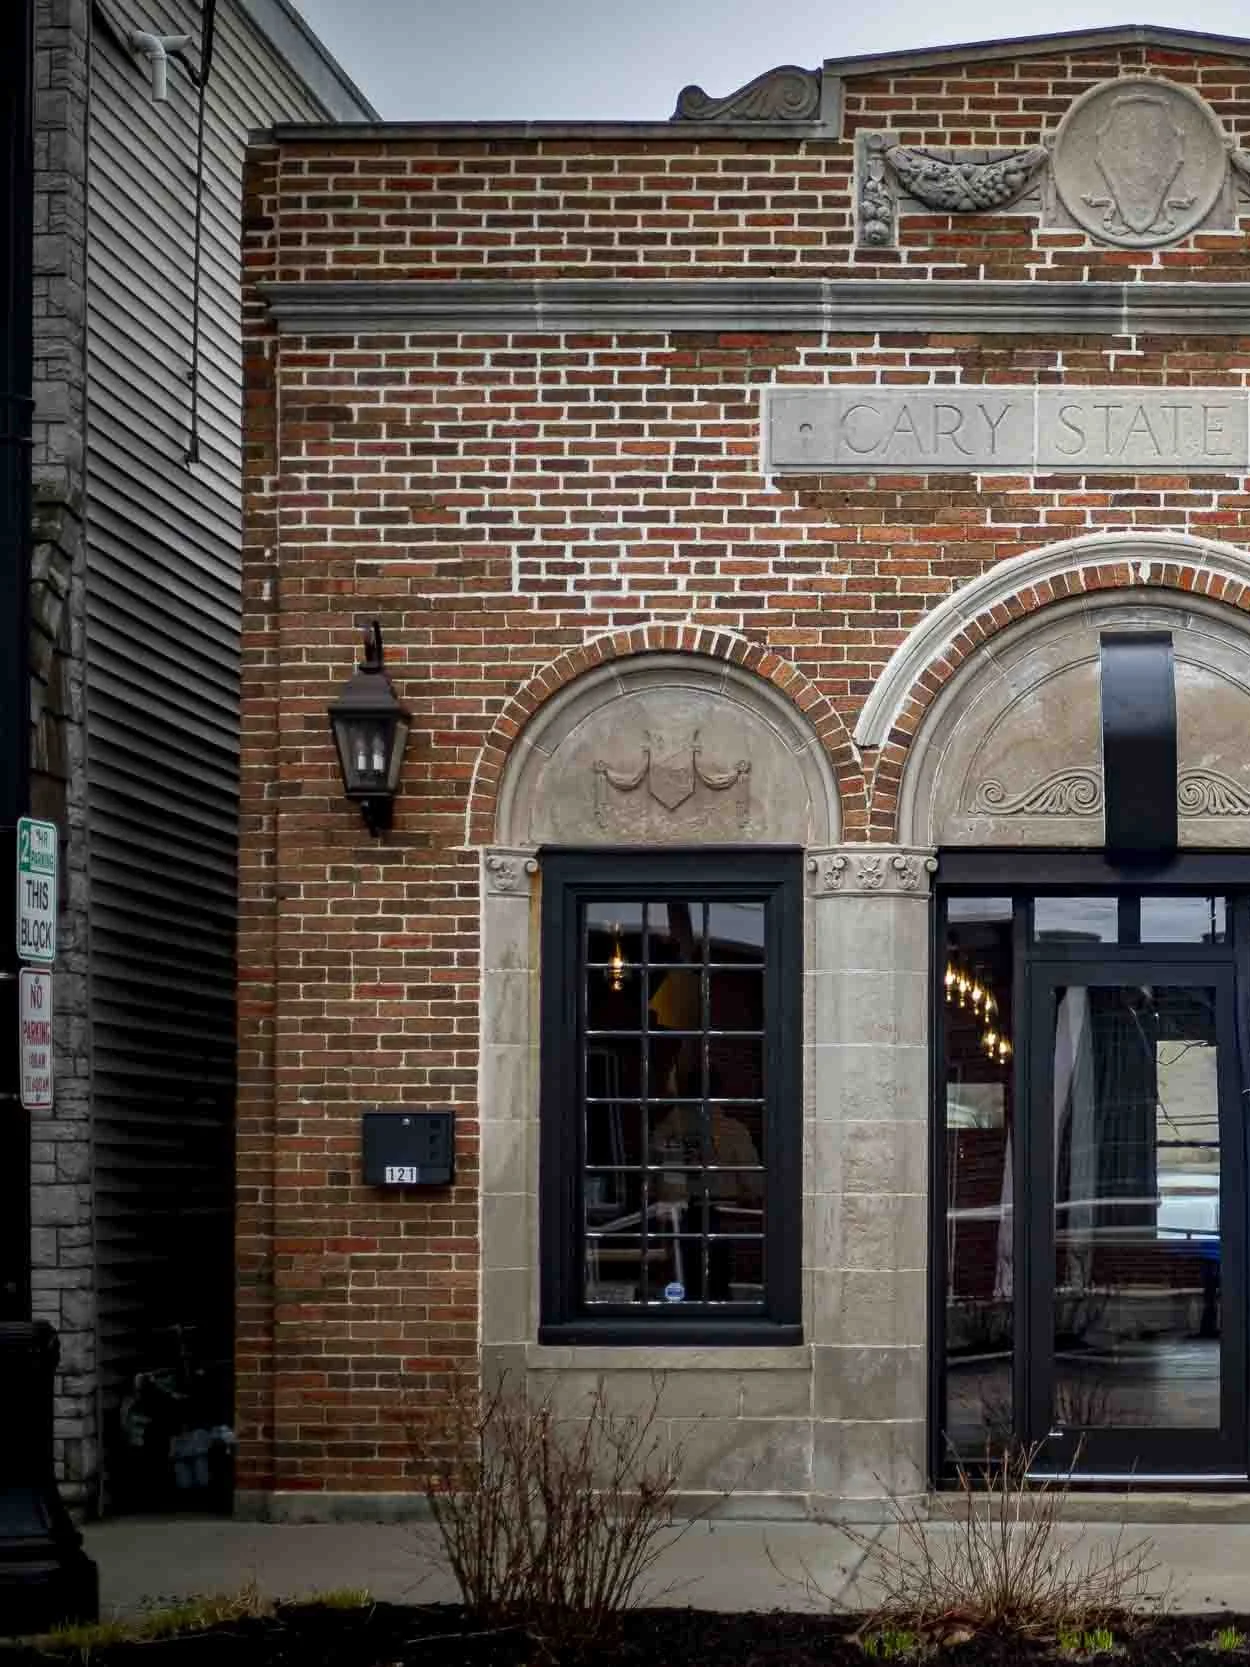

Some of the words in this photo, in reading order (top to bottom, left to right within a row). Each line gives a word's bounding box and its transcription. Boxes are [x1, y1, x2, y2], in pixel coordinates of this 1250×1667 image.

[841, 404, 1012, 455] CARY
[1055, 404, 1232, 455] STATE
[26, 880, 49, 910] THIS
[21, 917, 52, 949] BLOCK
[30, 984, 42, 1008] NO
[24, 1020, 50, 1045] PARKING
[389, 1168, 414, 1181] 121
